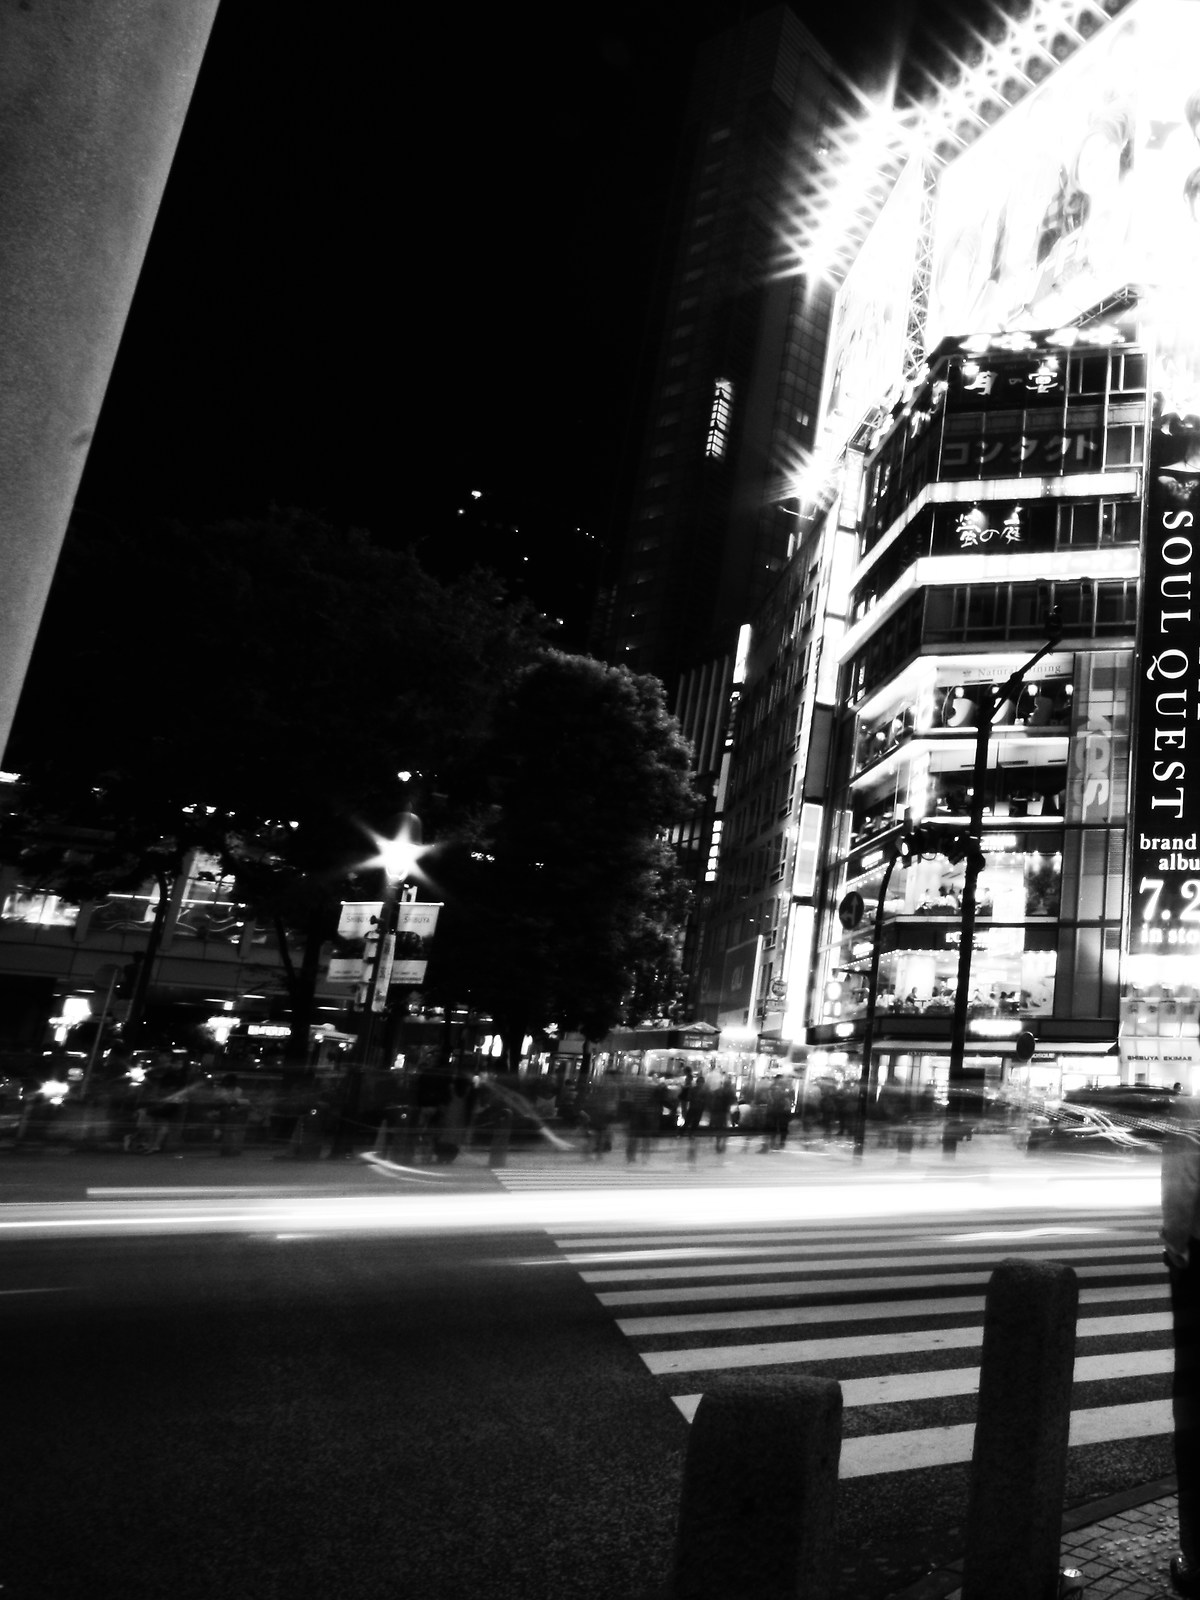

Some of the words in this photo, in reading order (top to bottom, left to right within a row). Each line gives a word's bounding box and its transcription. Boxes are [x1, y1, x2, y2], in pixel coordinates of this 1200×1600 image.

[943, 434, 1098, 466] コンタクト
[1160, 510, 1194, 633] SOUL
[1030, 664, 1061, 674] ining
[1146, 649, 1189, 819] QUEST
[1140, 833, 1197, 850] brand
[1141, 923, 1163, 943] in
